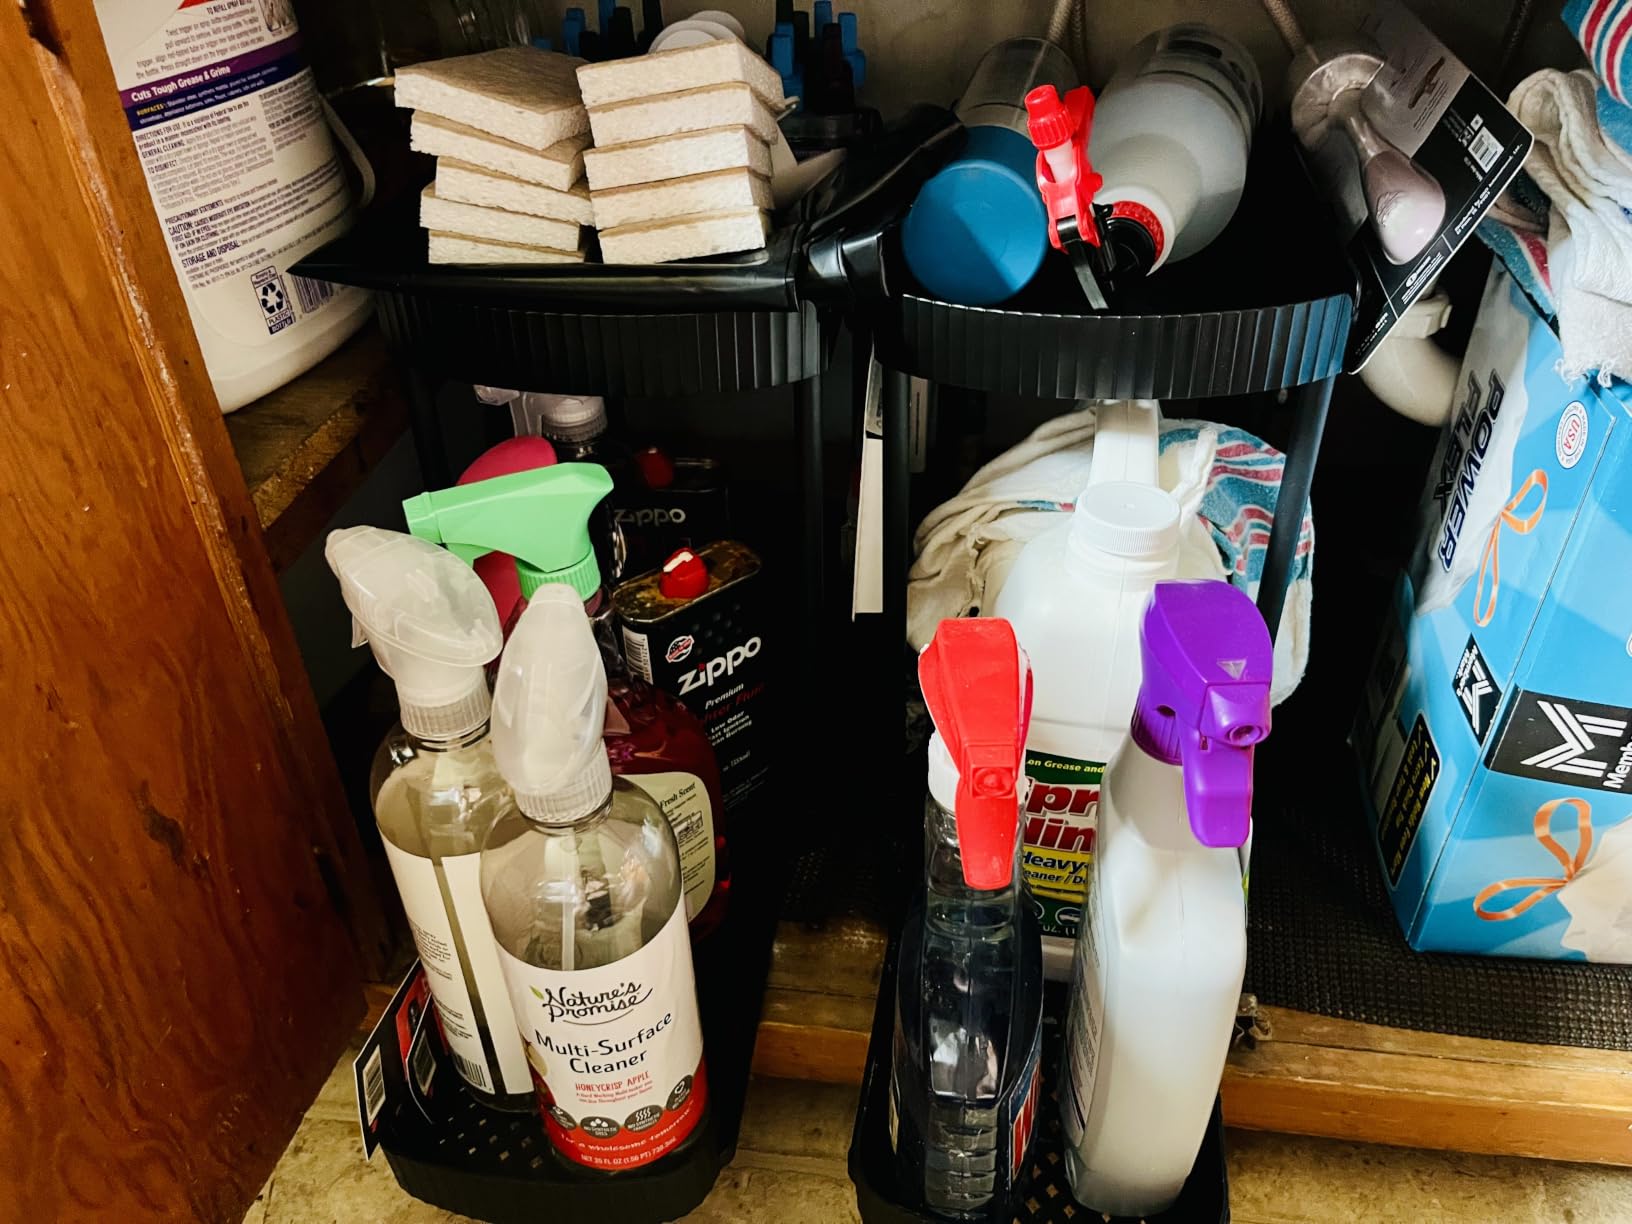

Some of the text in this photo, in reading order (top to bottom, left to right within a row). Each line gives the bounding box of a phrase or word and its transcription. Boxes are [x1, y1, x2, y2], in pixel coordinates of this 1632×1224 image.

[131, 65, 231, 102] Cuts Tough Grease & Grime
[181, 252, 207, 269] STORAGE
[206, 248, 218, 261] AND
[268, 310, 289, 326] PLASTIC
[1433, 369, 1482, 525] FLEX
[1563, 419, 1580, 450] USA
[1438, 368, 1506, 573] POWER
[705, 682, 745, 711] Premium
[711, 710, 745, 734] Low Odor
[1044, 760, 1081, 773] Grease
[1084, 764, 1105, 774] and
[1025, 868, 1063, 883] eaner
[541, 987, 654, 1023] Promise
[544, 981, 643, 1008] Nature's
[535, 1012, 673, 1058] Multi-Surface
[569, 1050, 648, 1075] Cleaner
[575, 1071, 649, 1092] HONEYCRISP APPLE
[587, 1138, 647, 1152] wholesome
[613, 1157, 623, 1165] OZ
